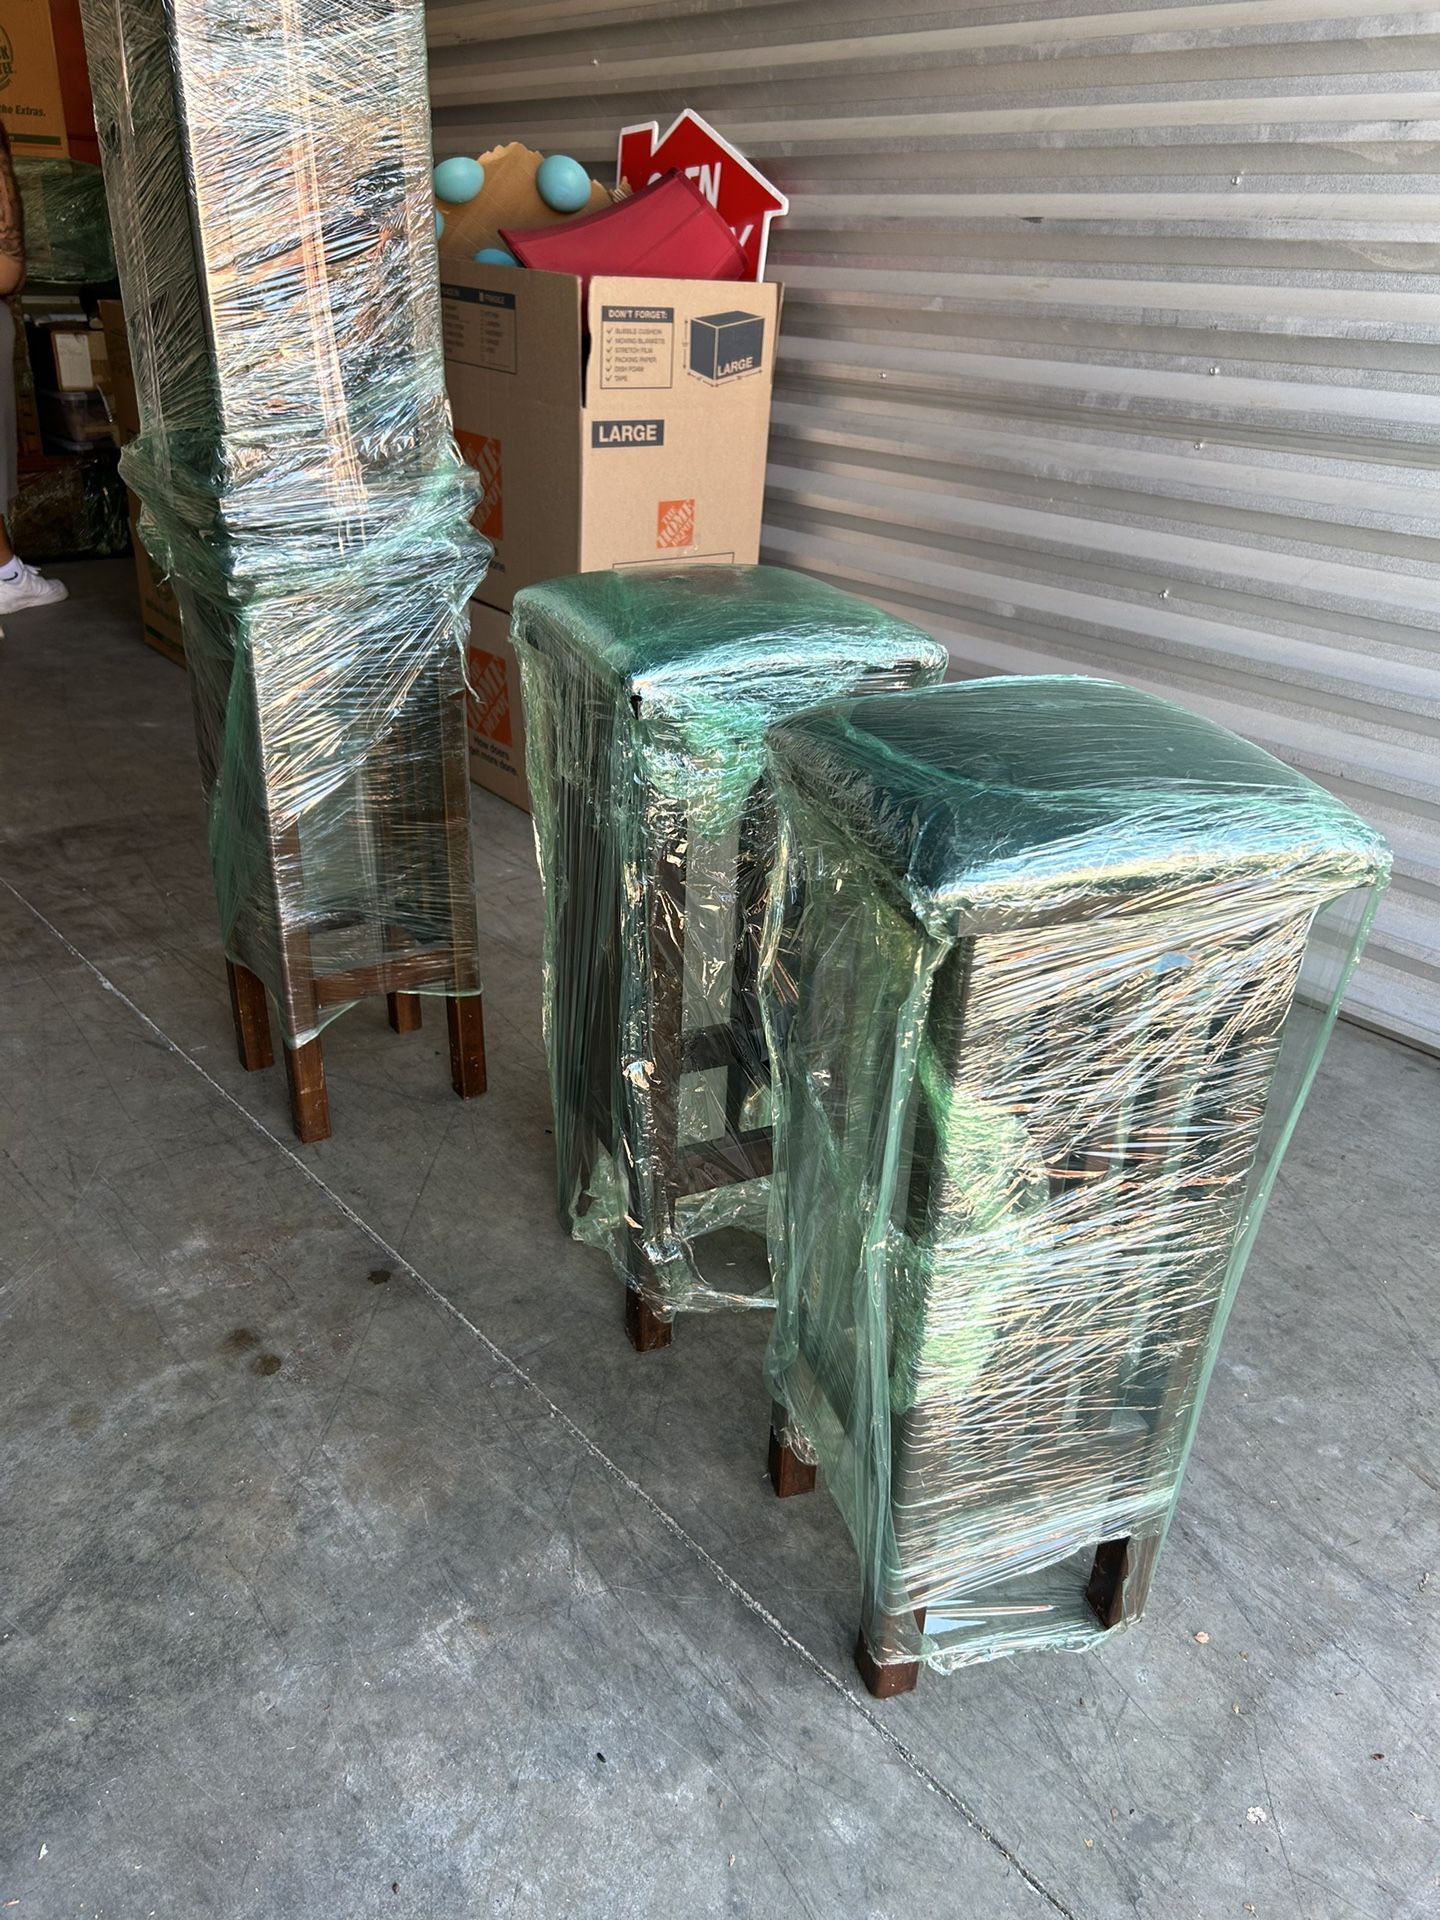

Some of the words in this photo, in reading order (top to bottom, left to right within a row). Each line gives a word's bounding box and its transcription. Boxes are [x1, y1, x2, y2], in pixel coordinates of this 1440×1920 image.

[15, 105, 46, 117] Extras.
[608, 309, 633, 319] DON'T
[634, 310, 668, 319] FORGET:
[718, 357, 753, 376] LARGE
[599, 424, 658, 443] LARGE
